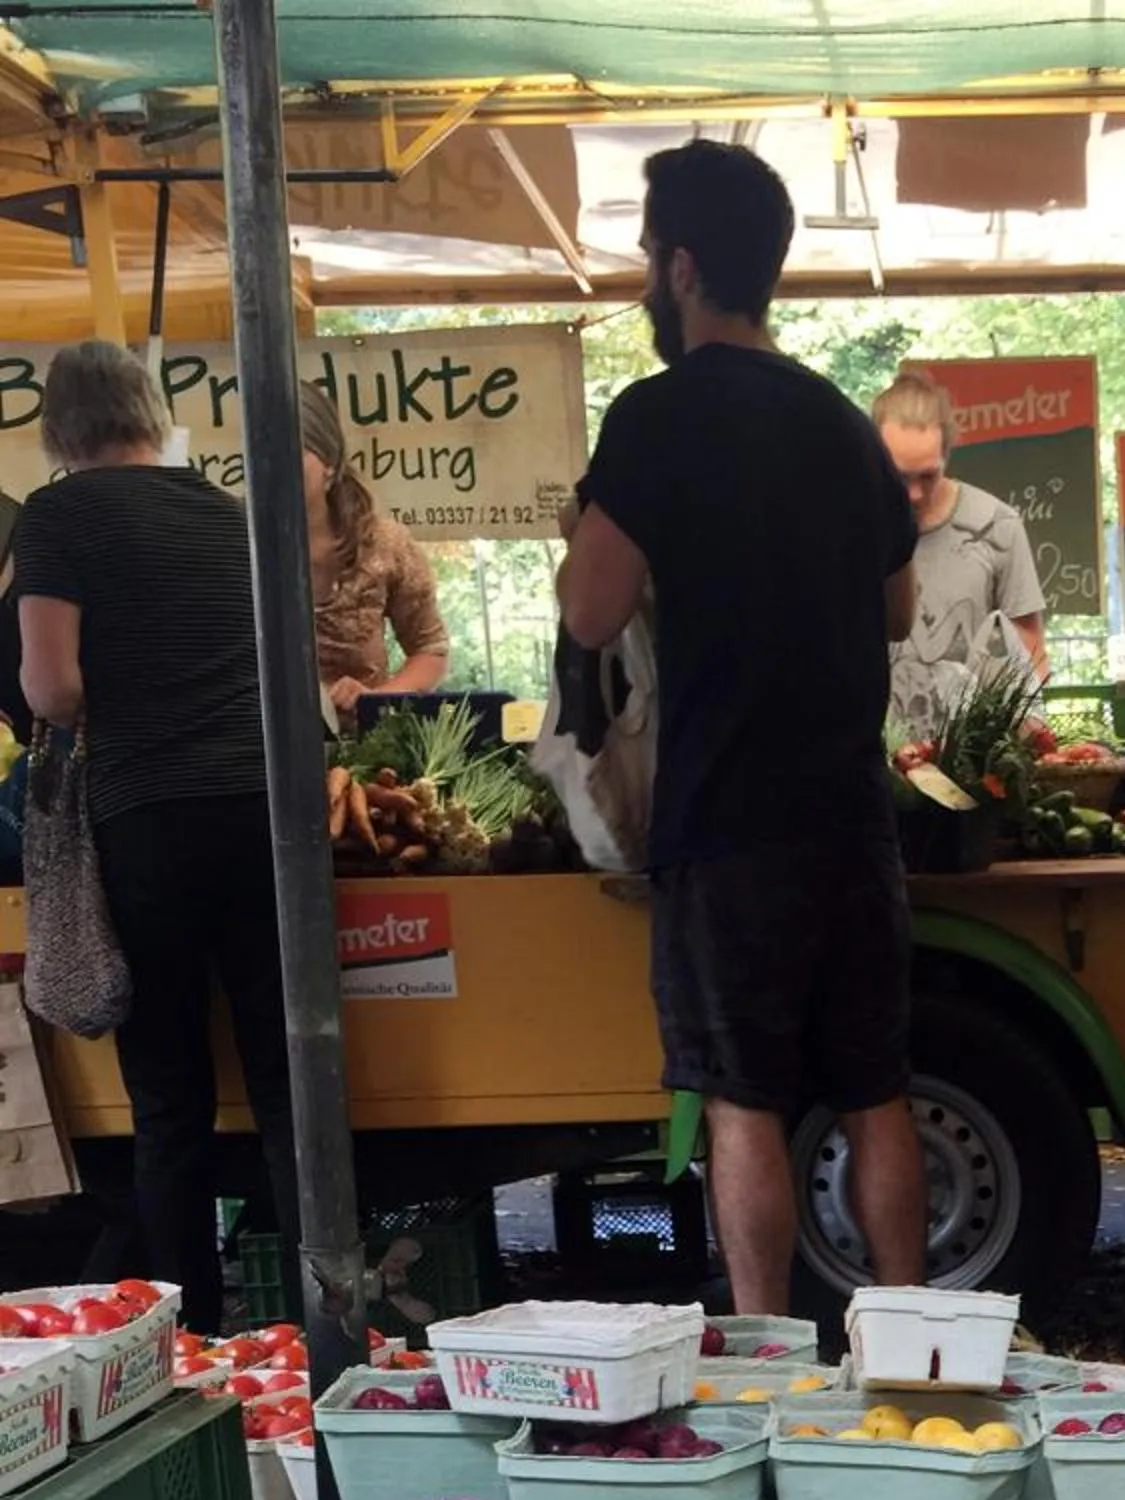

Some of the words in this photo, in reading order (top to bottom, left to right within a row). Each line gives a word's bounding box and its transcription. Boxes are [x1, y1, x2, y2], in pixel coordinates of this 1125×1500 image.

[160, 350, 519, 427] Prdukte
[950, 384, 1072, 433] emeter
[391, 507, 422, 526] Tel.
[426, 506, 474, 525] 03337
[490, 506, 508, 524] 21
[514, 506, 535, 524] 92
[338, 913, 429, 952] meter
